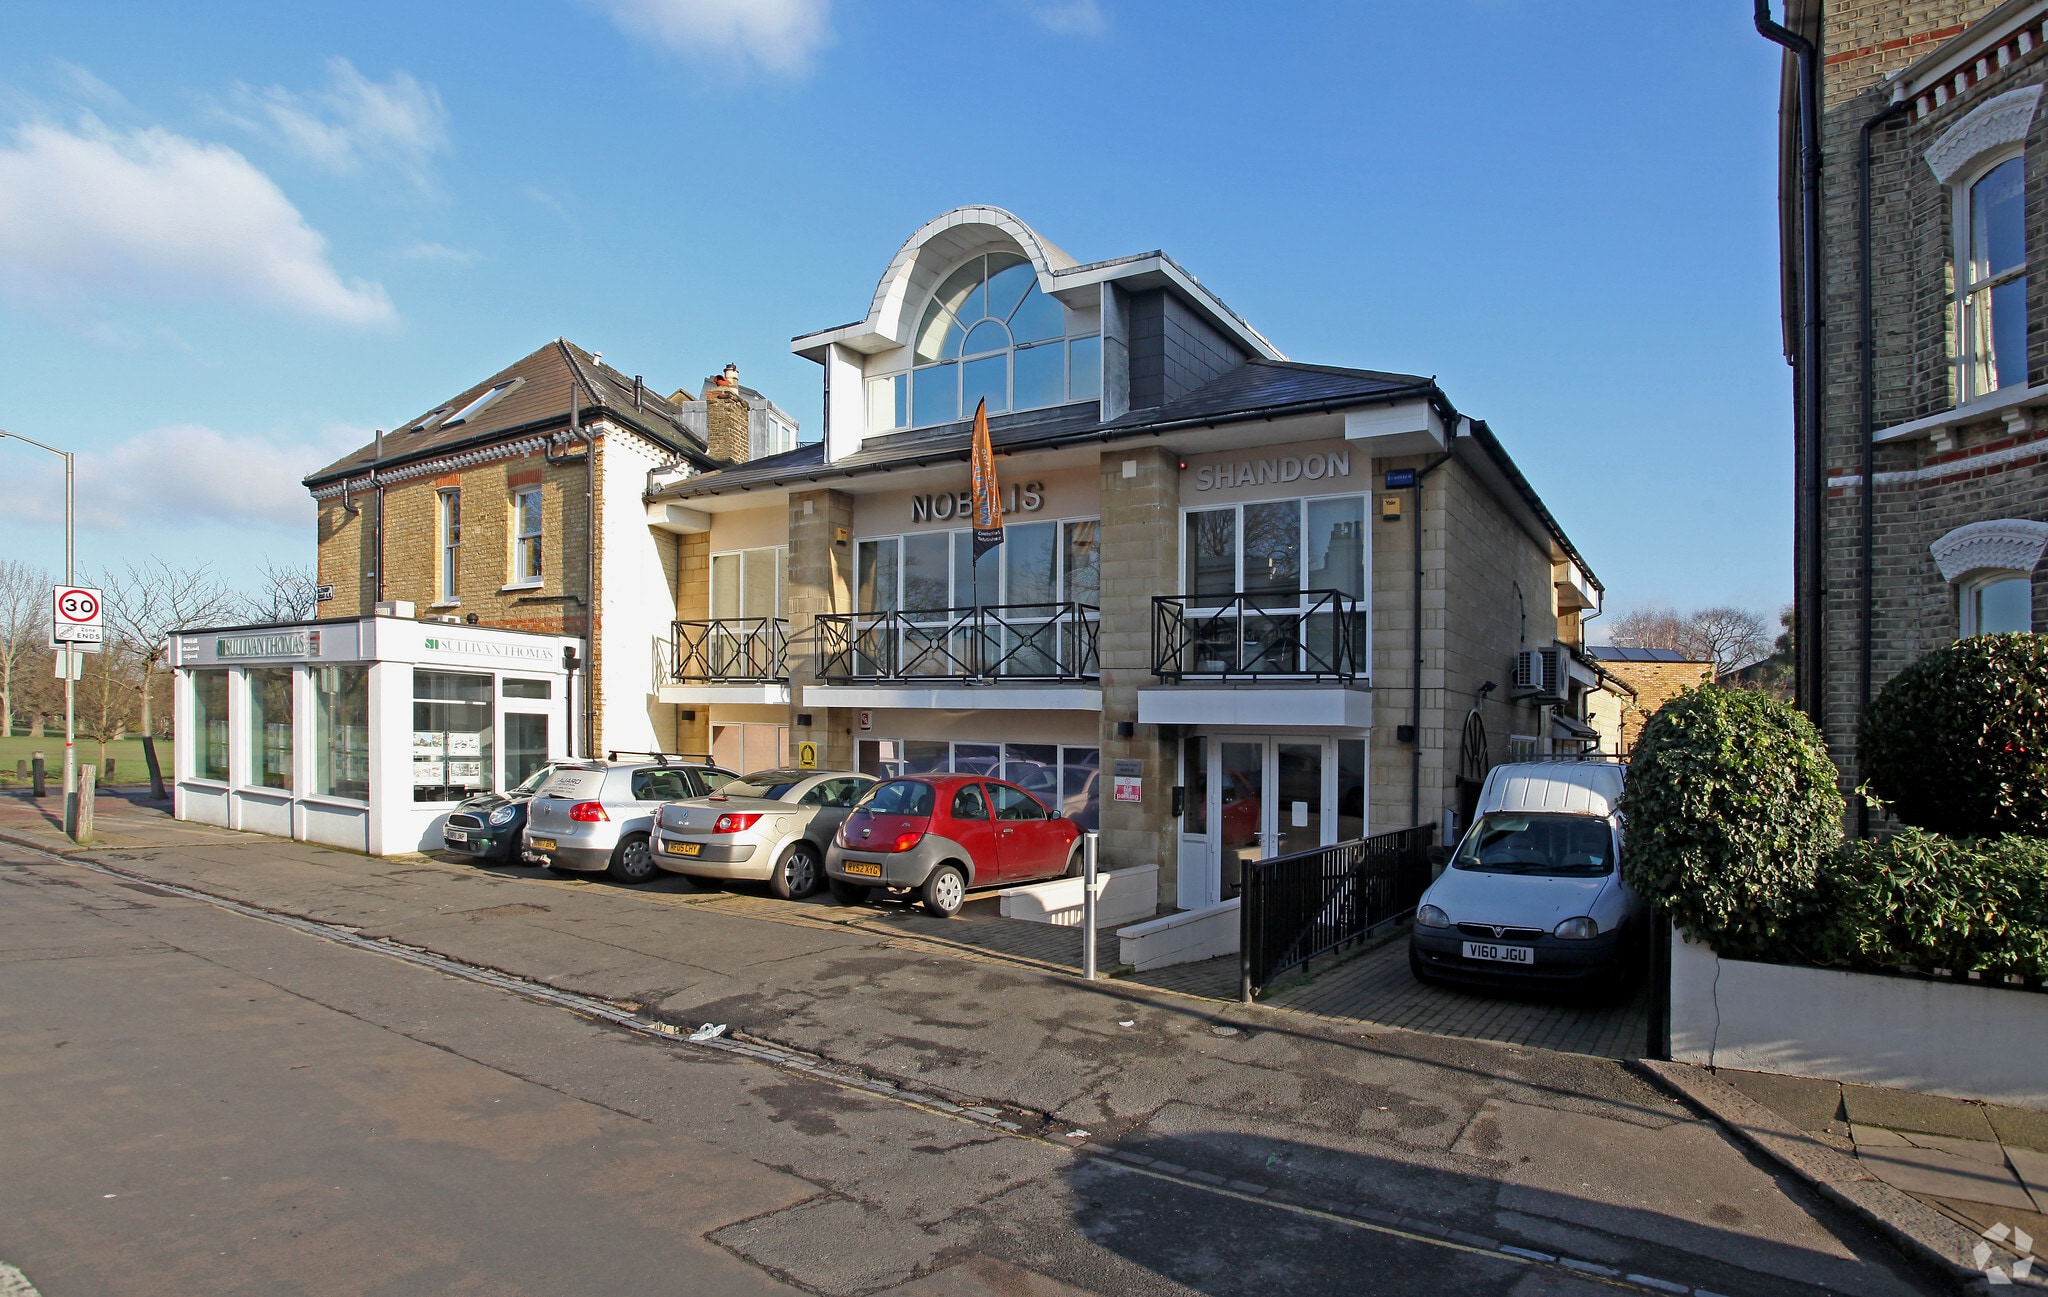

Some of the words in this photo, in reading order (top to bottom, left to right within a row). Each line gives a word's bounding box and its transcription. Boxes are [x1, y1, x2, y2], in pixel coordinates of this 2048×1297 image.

[1196, 451, 1350, 491] SHANDON
[911, 481, 1044, 522] NOBIS
[65, 599, 93, 613] 30
[225, 639, 266, 656] SULLIVAN
[267, 635, 304, 654] THOMAS
[441, 640, 500, 655] SULLIVAN
[503, 645, 553, 660] THOMAS
[847, 862, 864, 873] RY52
[865, 865, 878, 875] XYG
[1501, 948, 1527, 961] JGU
